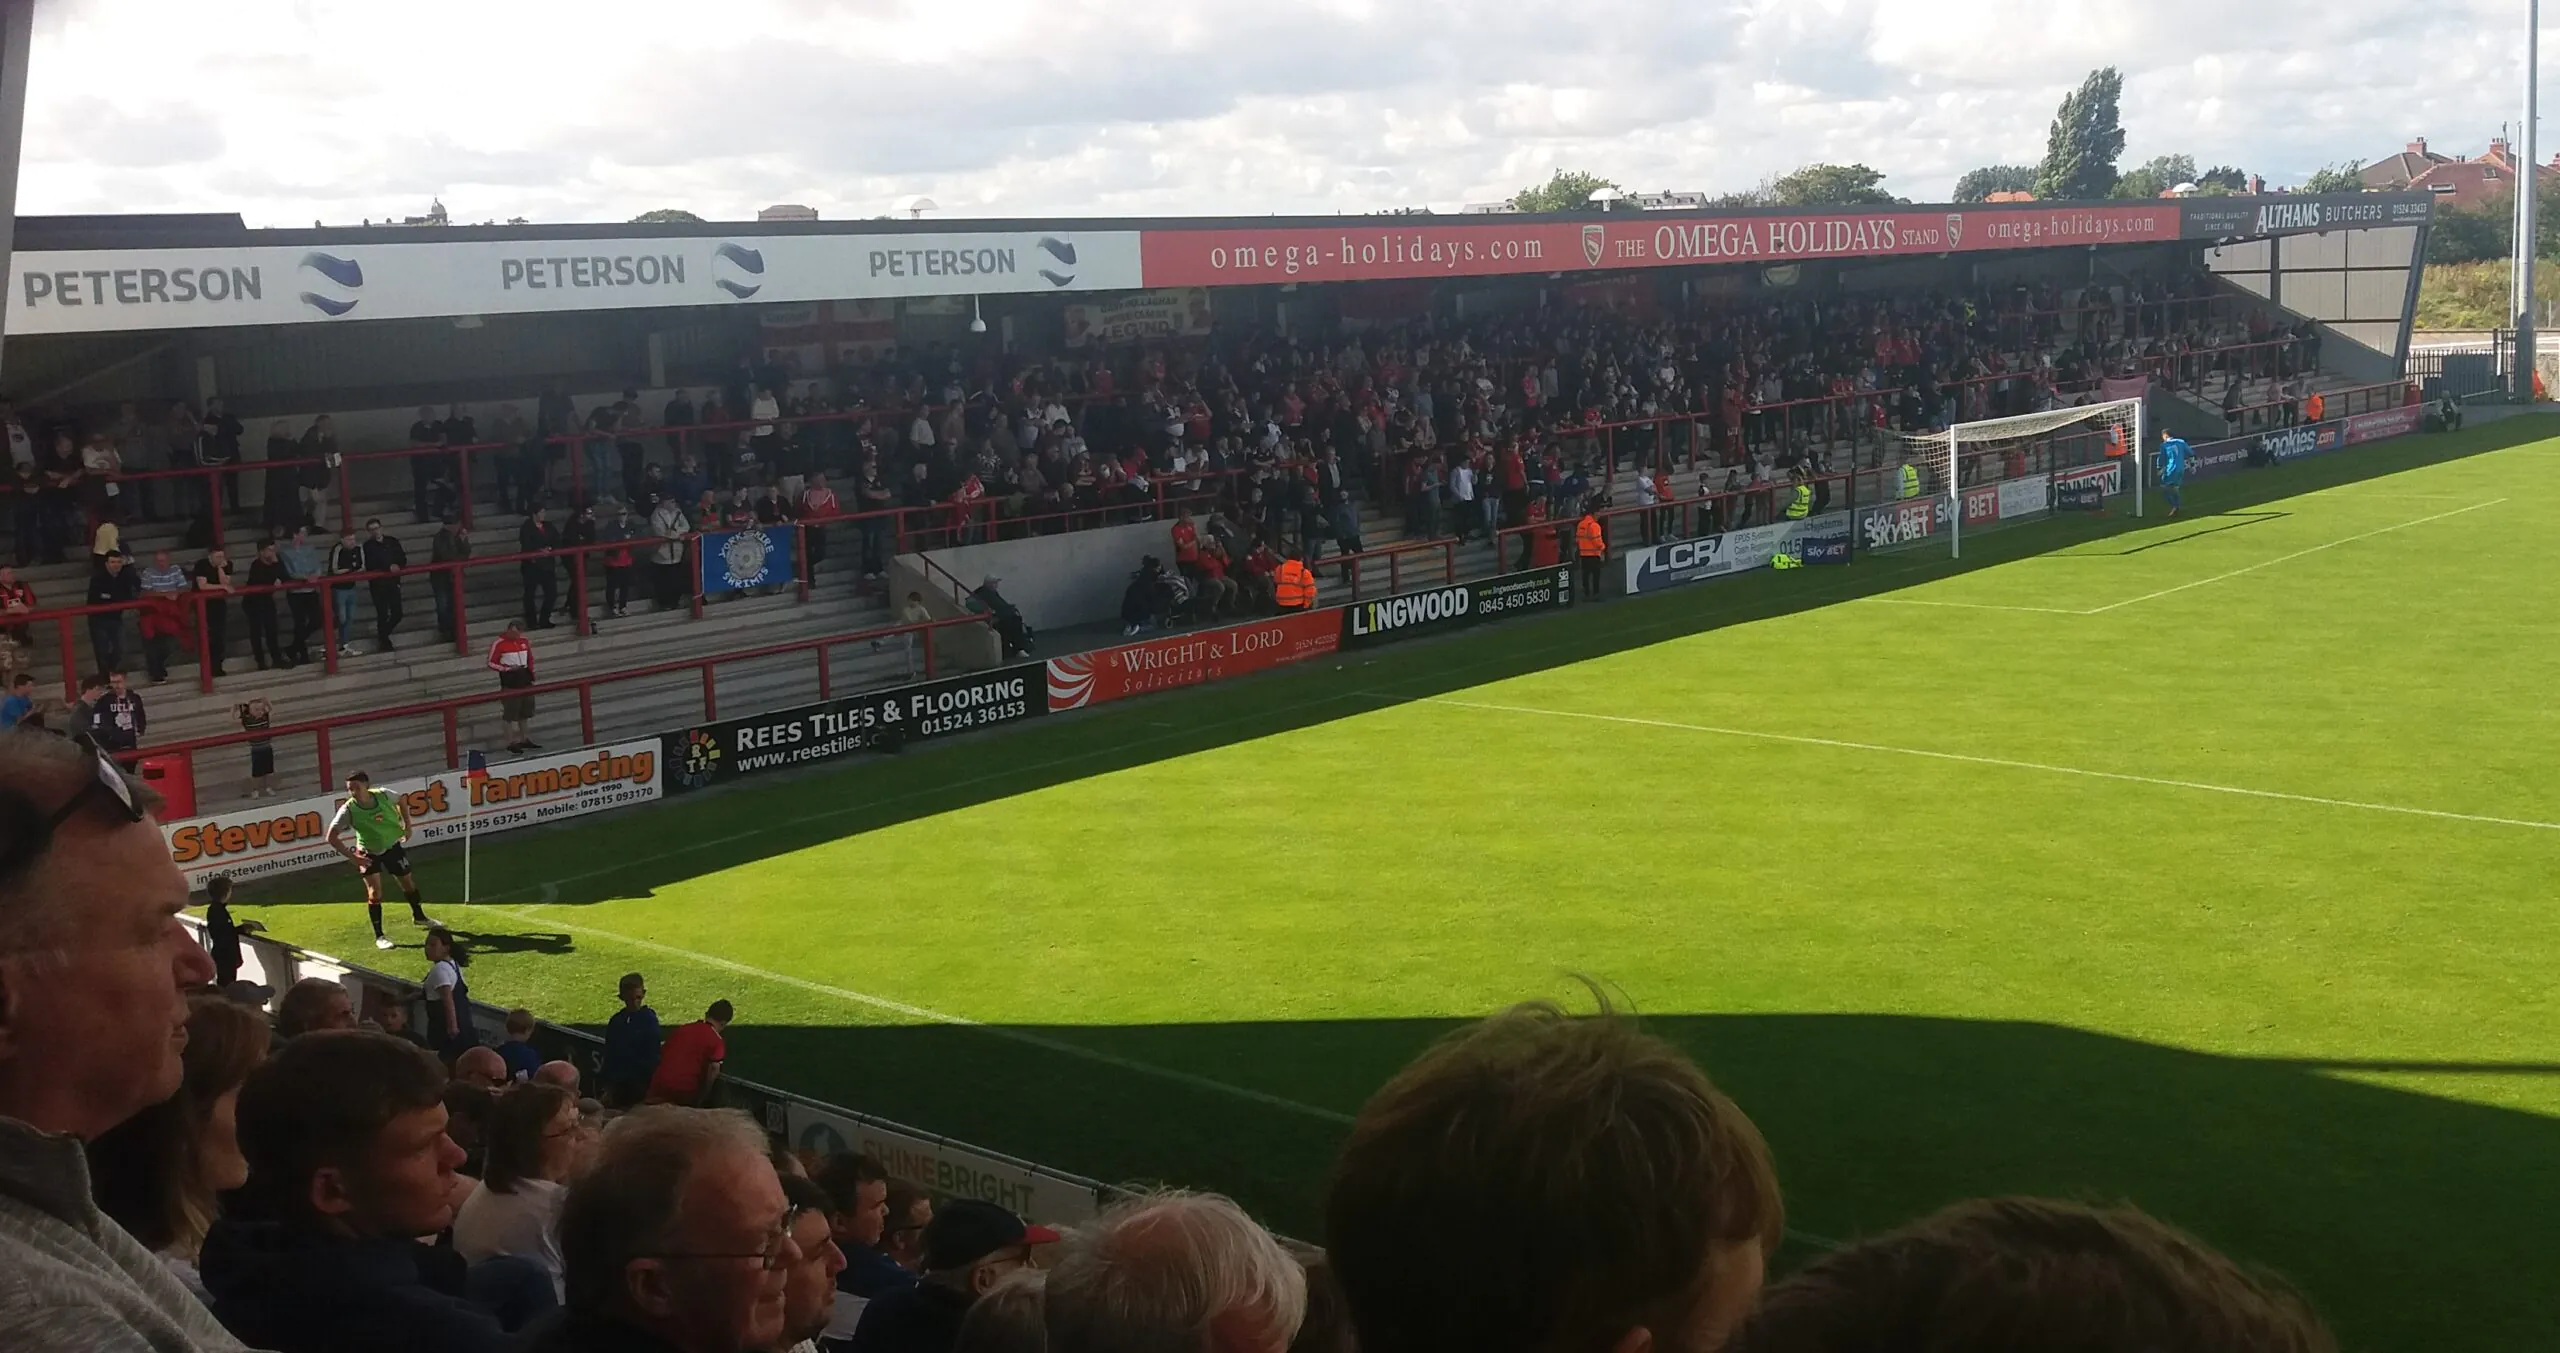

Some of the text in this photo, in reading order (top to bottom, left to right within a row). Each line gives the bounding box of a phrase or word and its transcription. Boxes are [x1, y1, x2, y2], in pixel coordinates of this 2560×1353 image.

[1987, 213, 2155, 240] omega-holidays.com
[2255, 203, 2382, 233] ALTHAMS BUTCHERS
[1211, 235, 1543, 274] omega-holidays.com
[1616, 218, 1939, 260] THE OMEGA HOLIDAYS STAND
[501, 255, 685, 290] PETERSON
[869, 247, 1016, 278] PETERSON
[23, 266, 262, 307] PETERSON
[1935, 496, 1962, 524] sky
[1969, 492, 1995, 518] BET
[718, 530, 774, 559] YORKSHIRE
[1649, 538, 1722, 574] LCR
[722, 566, 769, 589] SHRIMPS
[1479, 597, 1504, 614] 0845
[1506, 593, 1525, 609] 450
[1526, 588, 1550, 605] 5830
[1121, 641, 1207, 673] WRIGHT
[1210, 643, 1225, 659] &
[1231, 629, 1284, 655] LORD
[1123, 666, 1223, 693] Solicitors
[110, 703, 135, 712] UCLA
[736, 677, 1024, 752] REES TILES & FLOORING
[921, 700, 1026, 736] 01524 36153
[172, 810, 322, 862] Steven
[460, 750, 654, 805] Tarmacing
[537, 786, 653, 818] Mobile: 07815 093170
[576, 782, 623, 798] since 1990
[423, 811, 527, 839] Tel: 015395 63754
[862, 1139, 1035, 1213] SHINEBRIGHT
